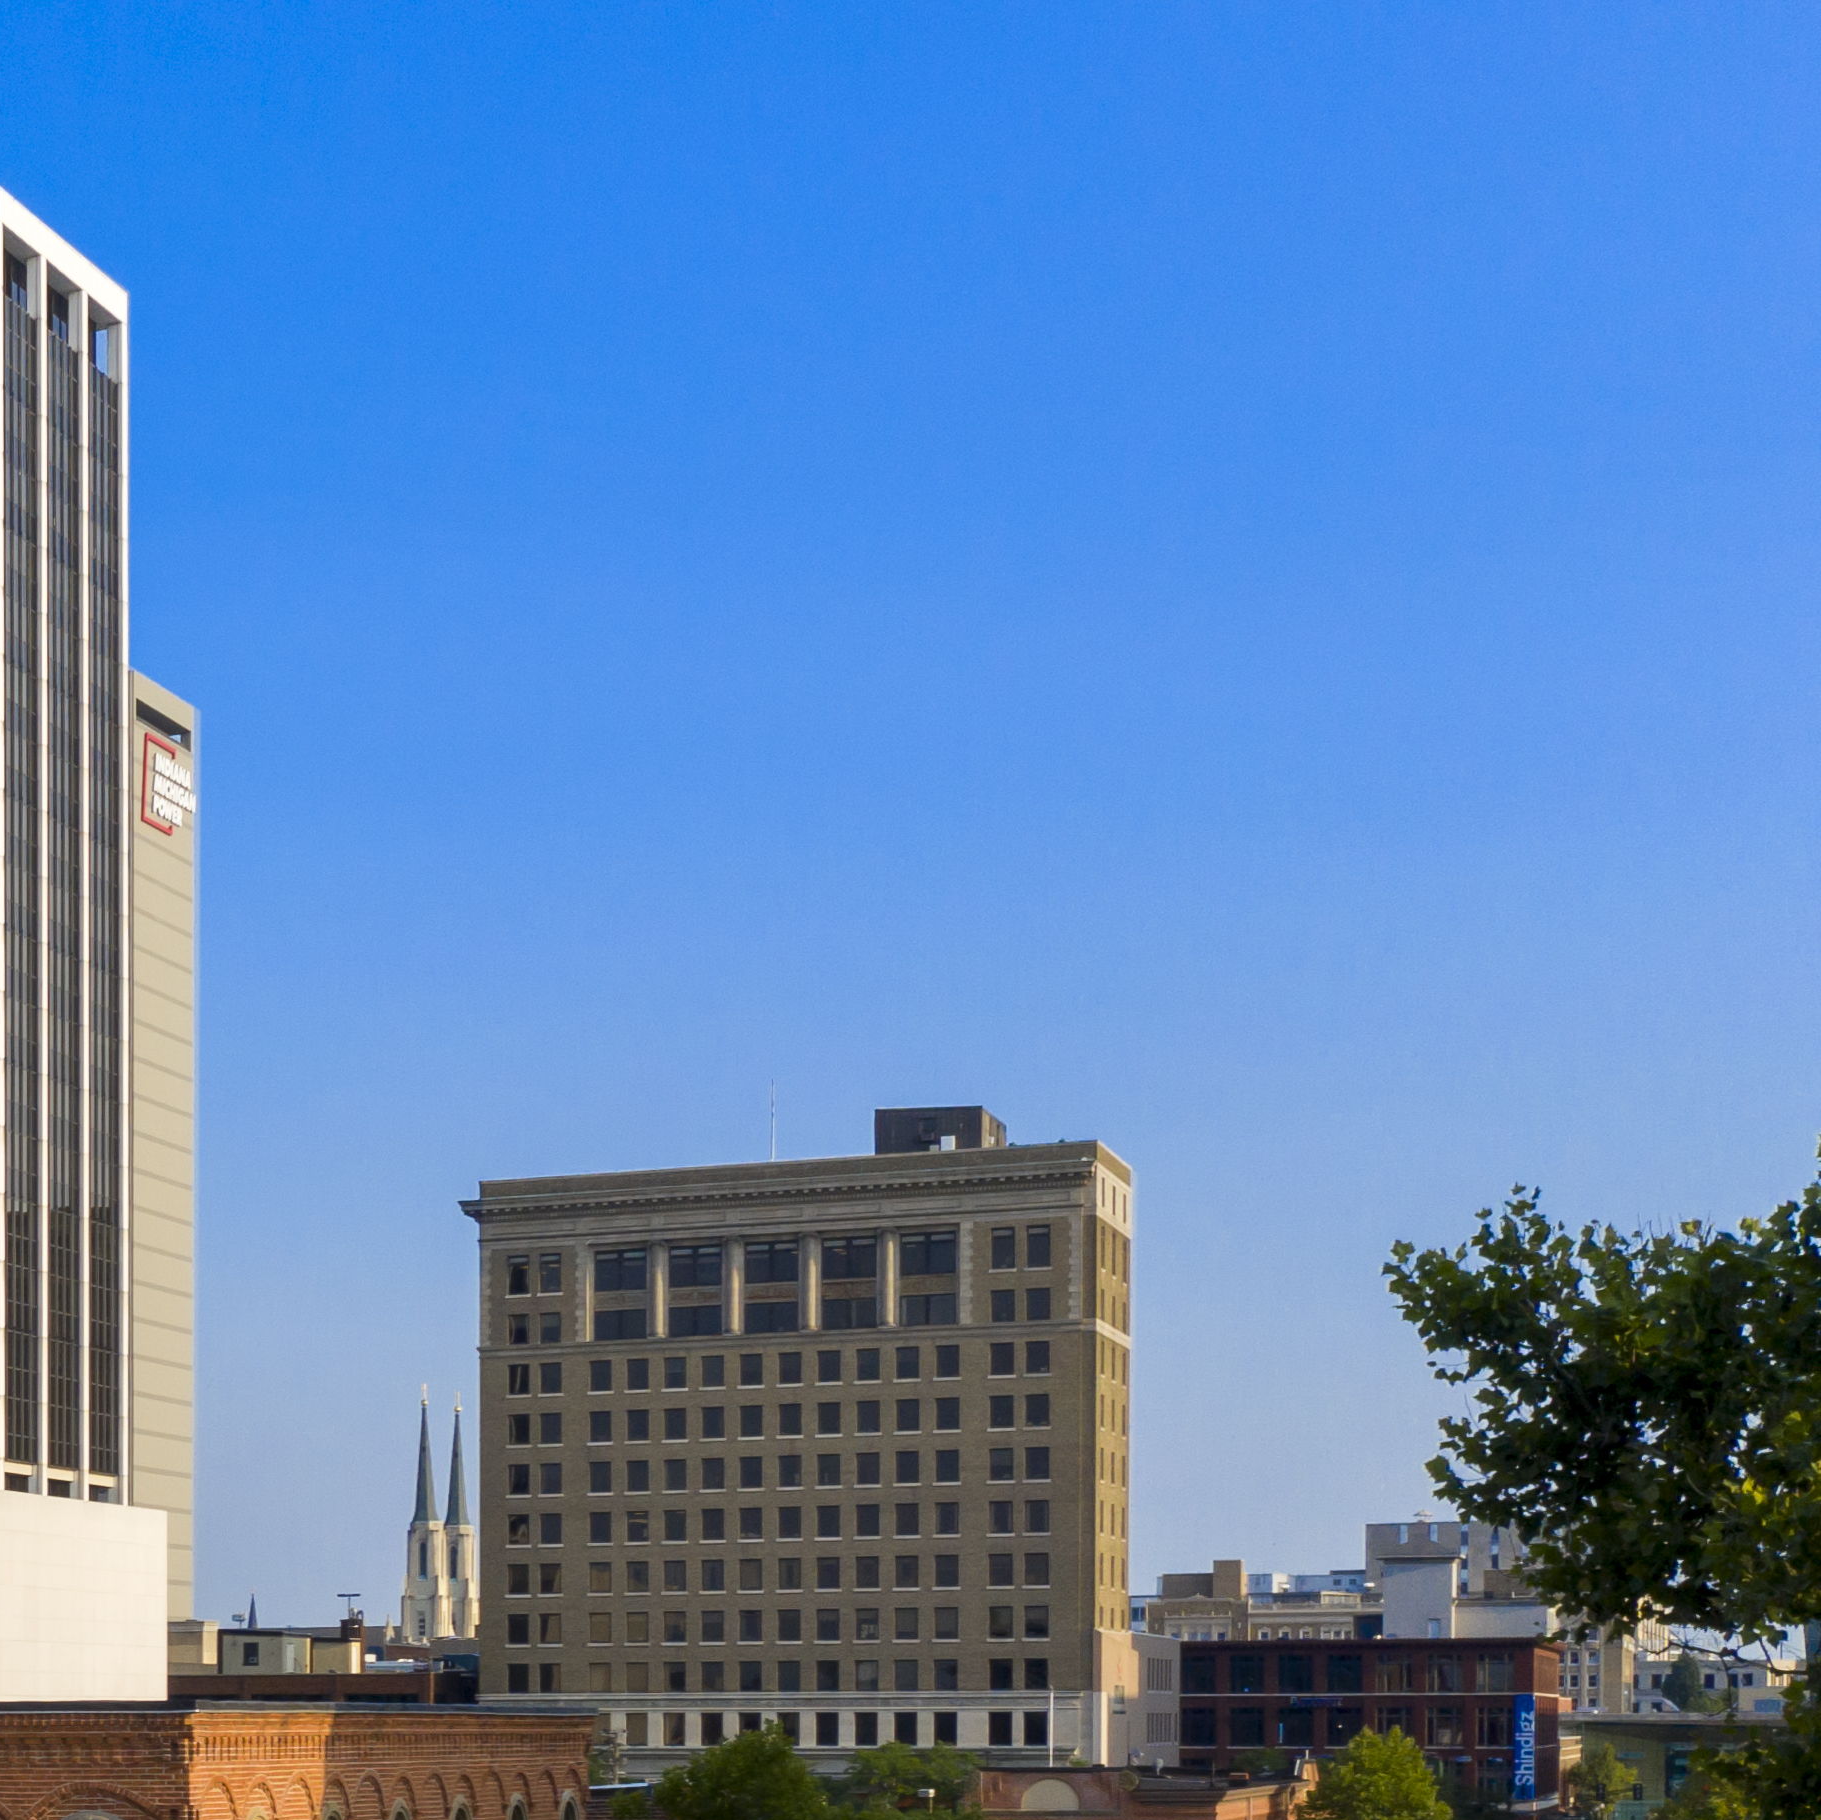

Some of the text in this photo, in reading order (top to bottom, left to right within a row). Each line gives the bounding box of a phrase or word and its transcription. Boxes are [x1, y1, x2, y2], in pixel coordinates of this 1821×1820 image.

[155, 752, 191, 790] INDIANA
[153, 774, 196, 813] MICHIGAN
[1515, 1711, 1535, 1786] Shindigz
